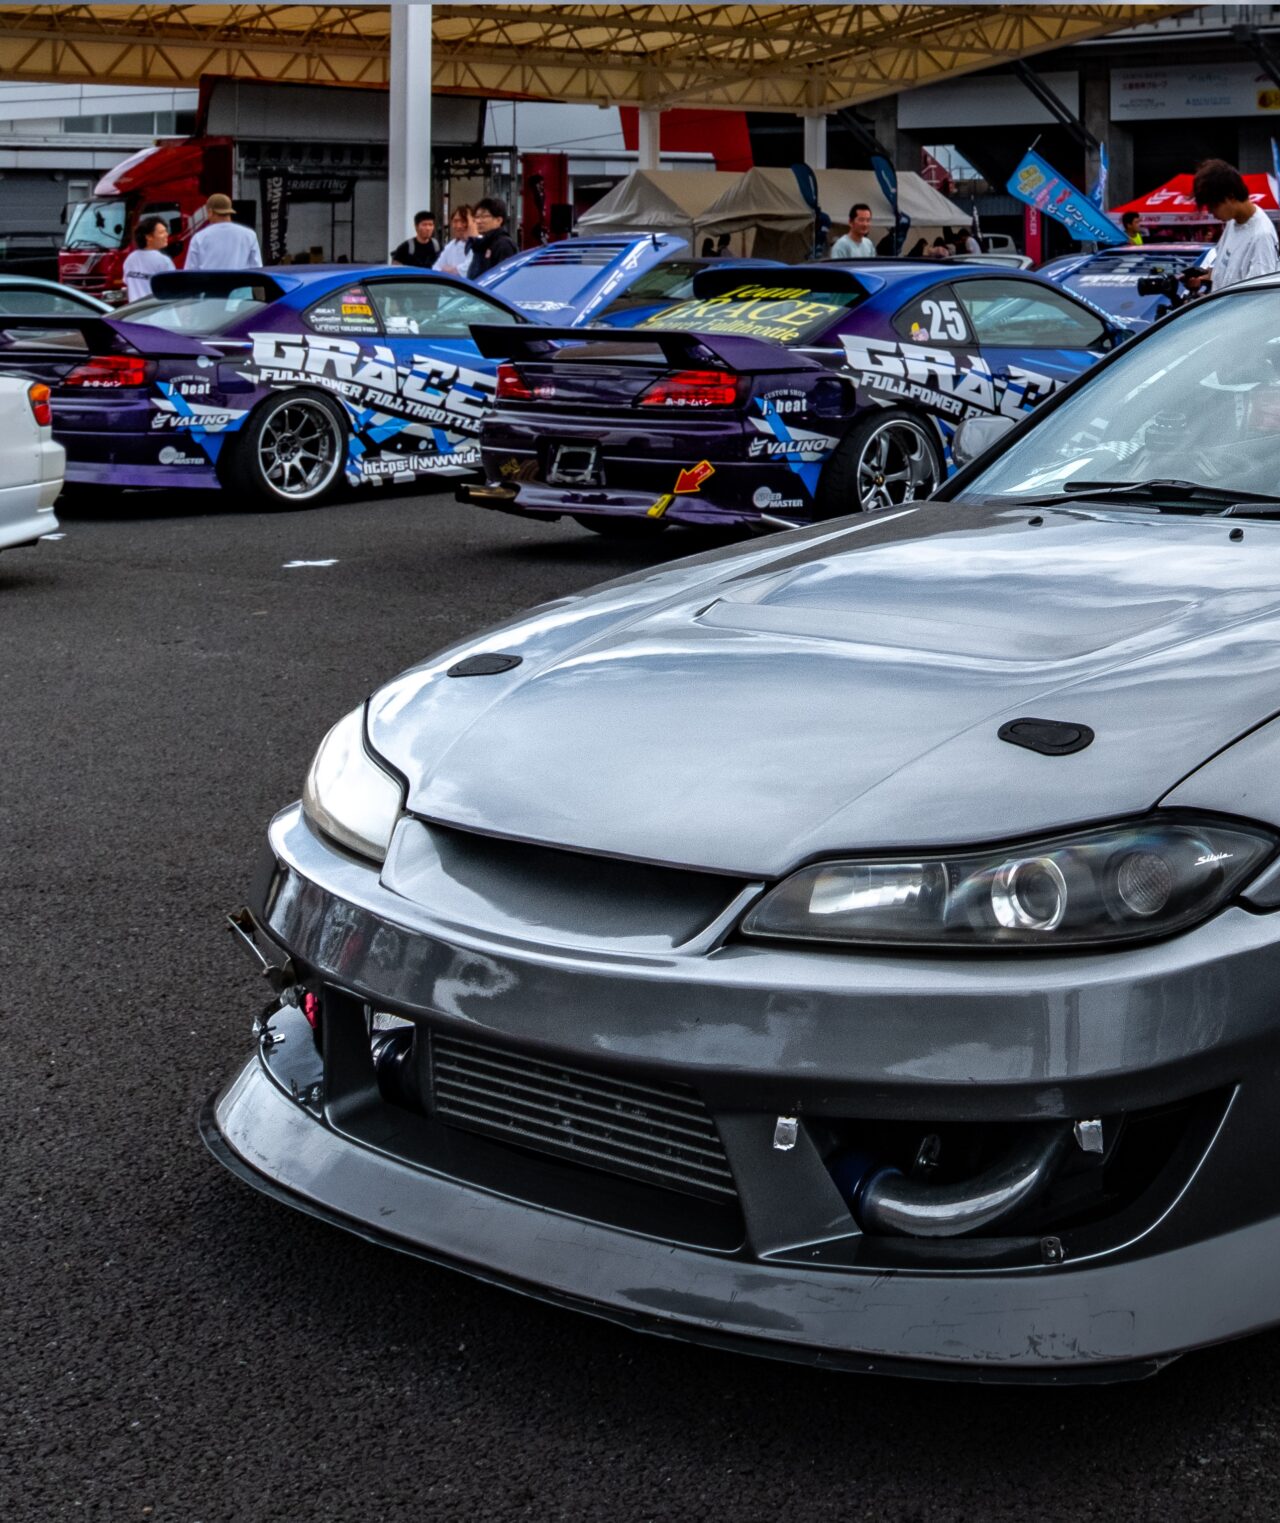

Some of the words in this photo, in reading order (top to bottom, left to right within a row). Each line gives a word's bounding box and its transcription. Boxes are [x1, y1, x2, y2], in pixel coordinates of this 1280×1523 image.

[719, 284, 811, 299] Team
[921, 300, 967, 341] 25
[248, 332, 497, 418] GRACE
[838, 334, 1066, 422] GRAC
[181, 383, 210, 395] beat
[260, 368, 362, 401] FULLPOWER
[764, 389, 789, 400] CUSTOM
[789, 389, 806, 399] SHOP
[861, 372, 962, 414] FULLPOWER
[776, 398, 807, 414] beat
[170, 414, 229, 427] VALINO
[767, 440, 828, 454] VALINO
[769, 499, 804, 508] MASTER
